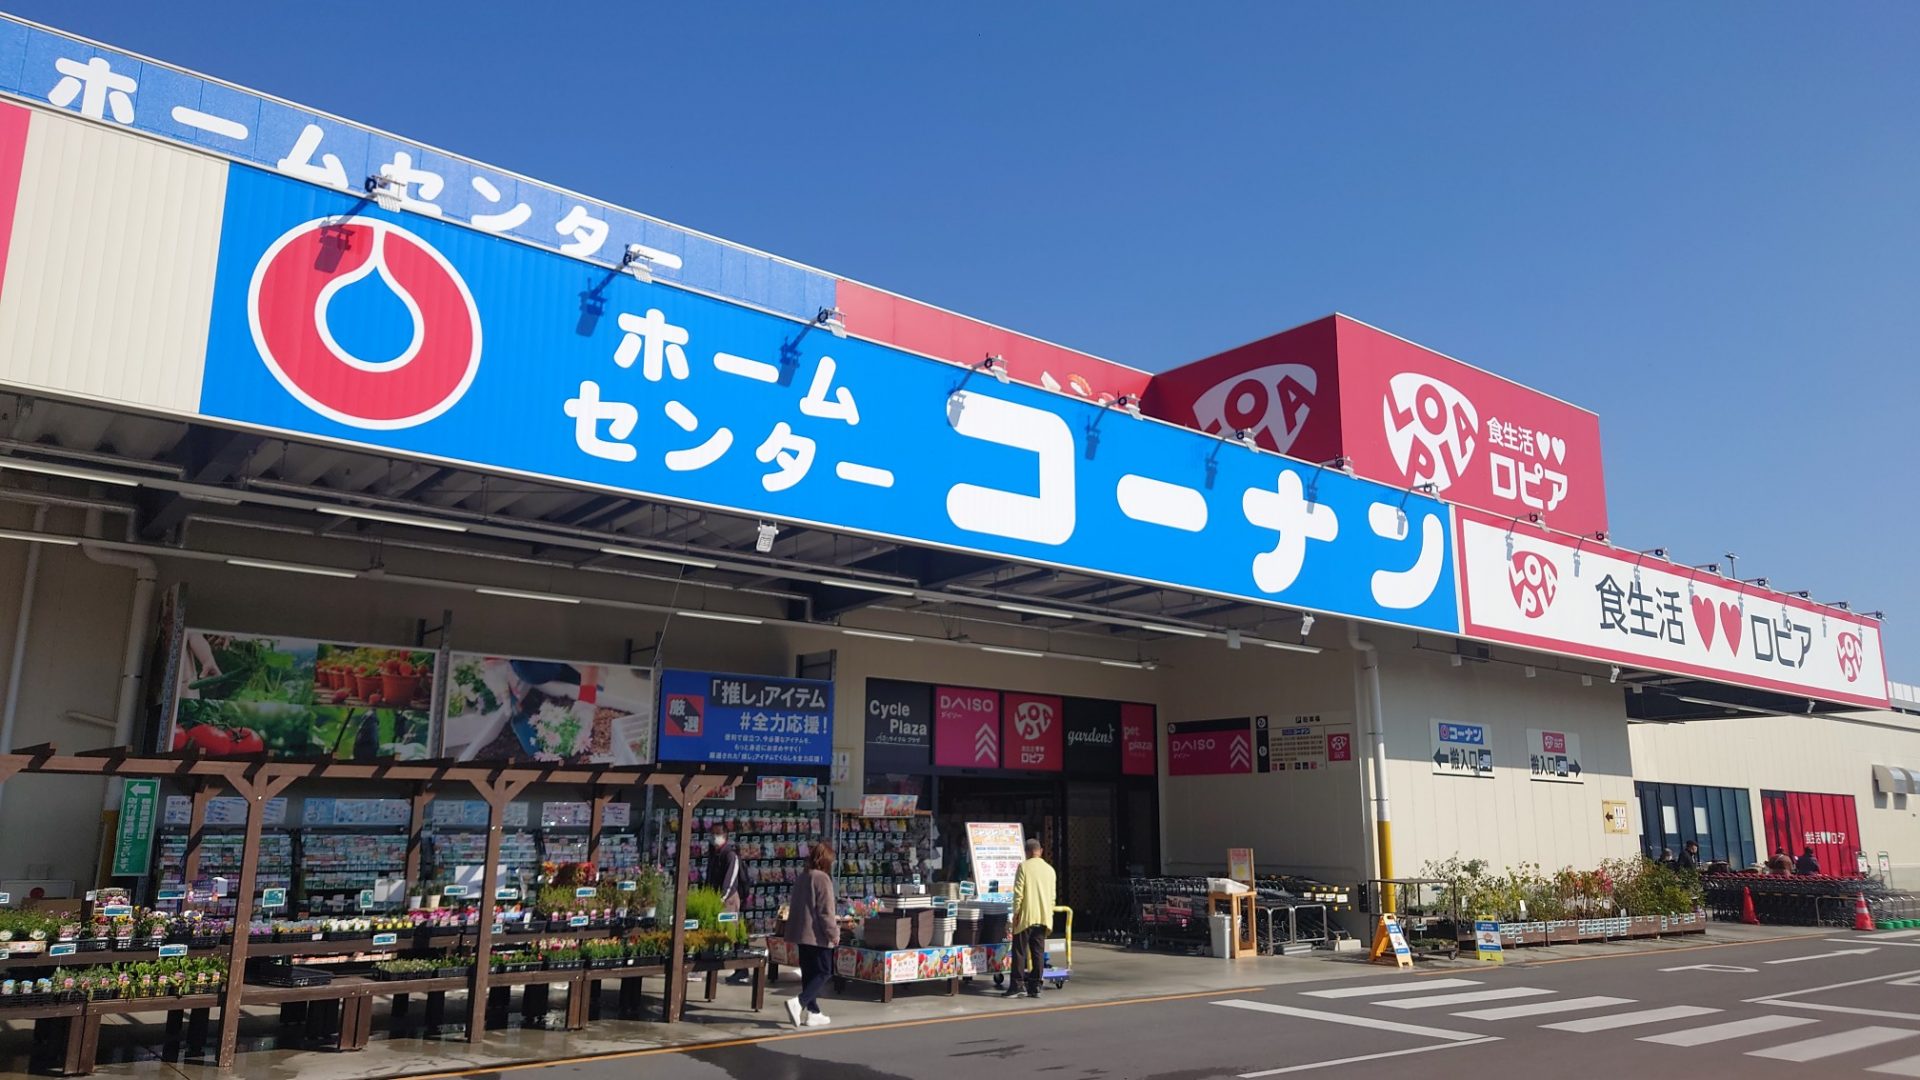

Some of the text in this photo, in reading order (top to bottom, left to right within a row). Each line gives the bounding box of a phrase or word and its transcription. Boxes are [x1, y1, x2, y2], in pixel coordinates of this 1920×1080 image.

[48, 57, 683, 270] ホームセンター
[613, 308, 860, 426] ホーム
[563, 381, 895, 493] センター
[1486, 415, 1534, 457] 食生活
[1489, 451, 1568, 512] ロピア
[945, 389, 1445, 610] コーナン
[1508, 551, 1558, 619] LOPIA
[1594, 573, 1812, 670] 食生活 ロピア
[711, 679, 826, 708] 「推し」アイテム
[940, 695, 994, 713] DAISO
[869, 699, 911, 720] Cycle
[889, 718, 927, 736] Plaza
[1123, 725, 1141, 740] pet
[1449, 726, 1482, 742] コーナン
[1128, 740, 1153, 752] plaza
[1172, 738, 1216, 752] DAISO
[1021, 752, 1044, 763] ロピア
[1450, 747, 1478, 771] 搬入口
[1530, 753, 1556, 776] 搬入口
